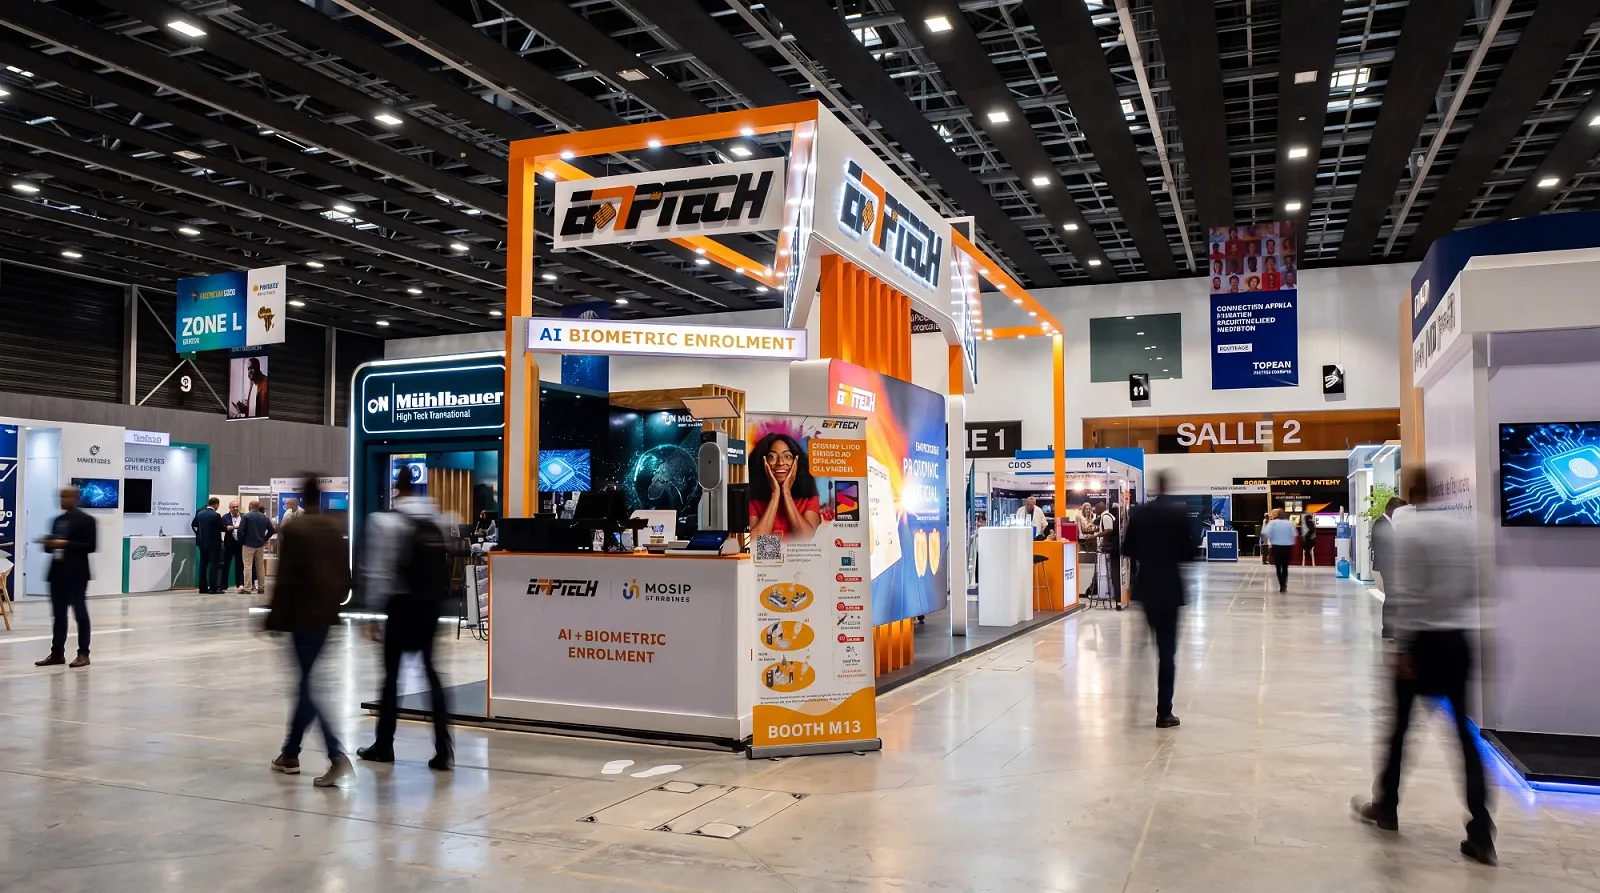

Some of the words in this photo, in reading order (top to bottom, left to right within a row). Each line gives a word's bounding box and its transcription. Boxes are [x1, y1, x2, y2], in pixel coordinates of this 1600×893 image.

[182, 313, 227, 337] ZONE
[232, 312, 242, 331] L
[539, 328, 562, 342] AI
[569, 328, 678, 346] BIOMETRIC
[684, 333, 796, 350] ENROLMENT
[1253, 361, 1291, 370] TOPEAN
[180, 375, 192, 392] 9
[396, 391, 504, 409] Mühlbauer
[396, 412, 412, 423] High
[994, 428, 1005, 450] 1
[1176, 420, 1274, 447] SALLE
[1282, 419, 1302, 444] 2
[645, 583, 692, 595] MOSIP
[558, 628, 572, 640] AI
[585, 630, 667, 646] BIOMETRIC
[568, 646, 655, 663] ENROLMENT
[768, 722, 824, 739] BOOTH
[829, 720, 861, 734] M13
